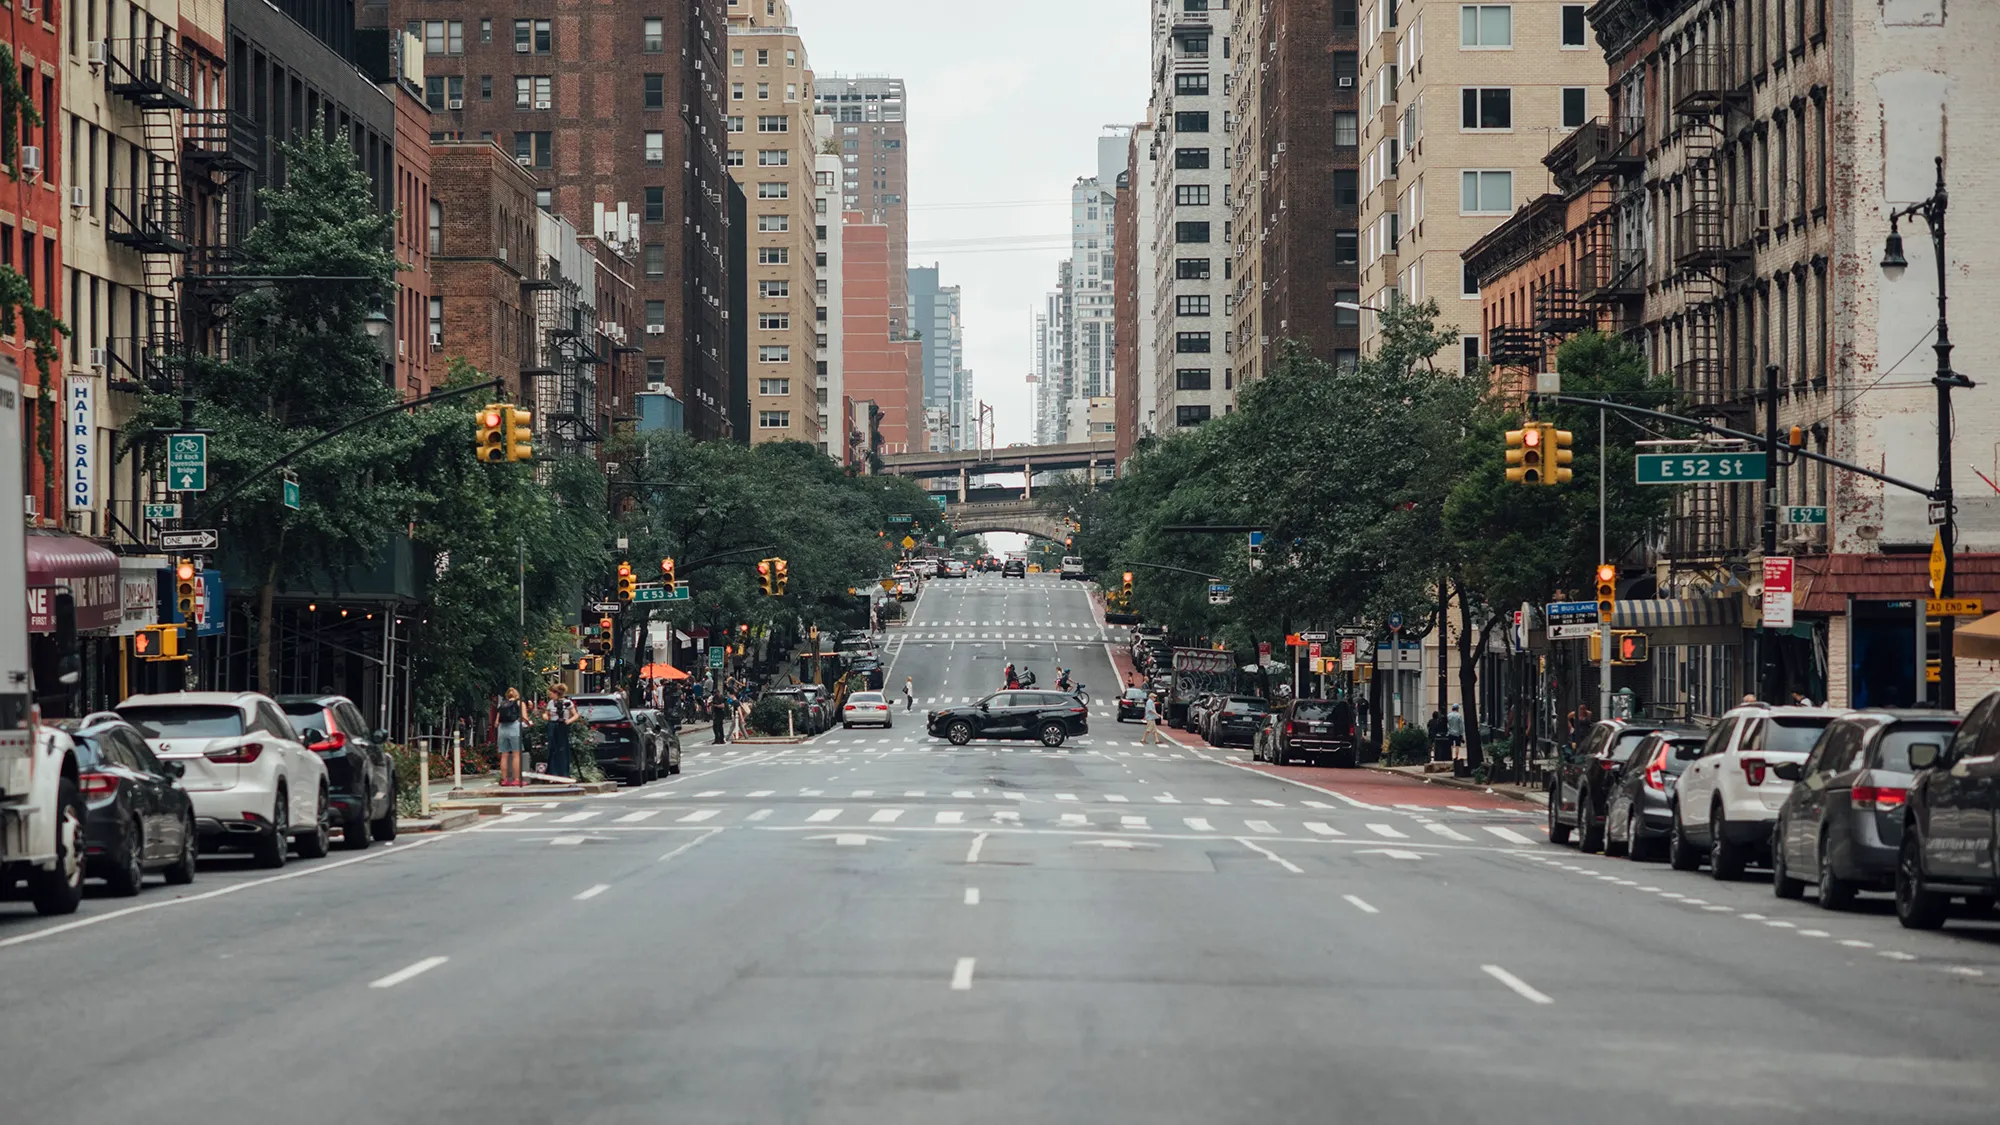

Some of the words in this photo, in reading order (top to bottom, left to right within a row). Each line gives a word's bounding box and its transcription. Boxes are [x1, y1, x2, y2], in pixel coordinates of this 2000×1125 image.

[75, 388, 88, 436] HAIR
[75, 444, 88, 506] SALON
[1662, 460, 1674, 476] E
[1682, 460, 1710, 476] 52
[1718, 459, 1743, 476] St
[146, 506, 151, 517] E
[154, 506, 163, 517] 52
[1790, 509, 1797, 522] E
[1800, 509, 1812, 522] 52
[99, 574, 115, 605] FIRST
[27, 588, 47, 614] NE
[1926, 603, 1941, 612] EAD
[1946, 603, 1962, 611] END
[32, 616, 47, 625] FIRST
